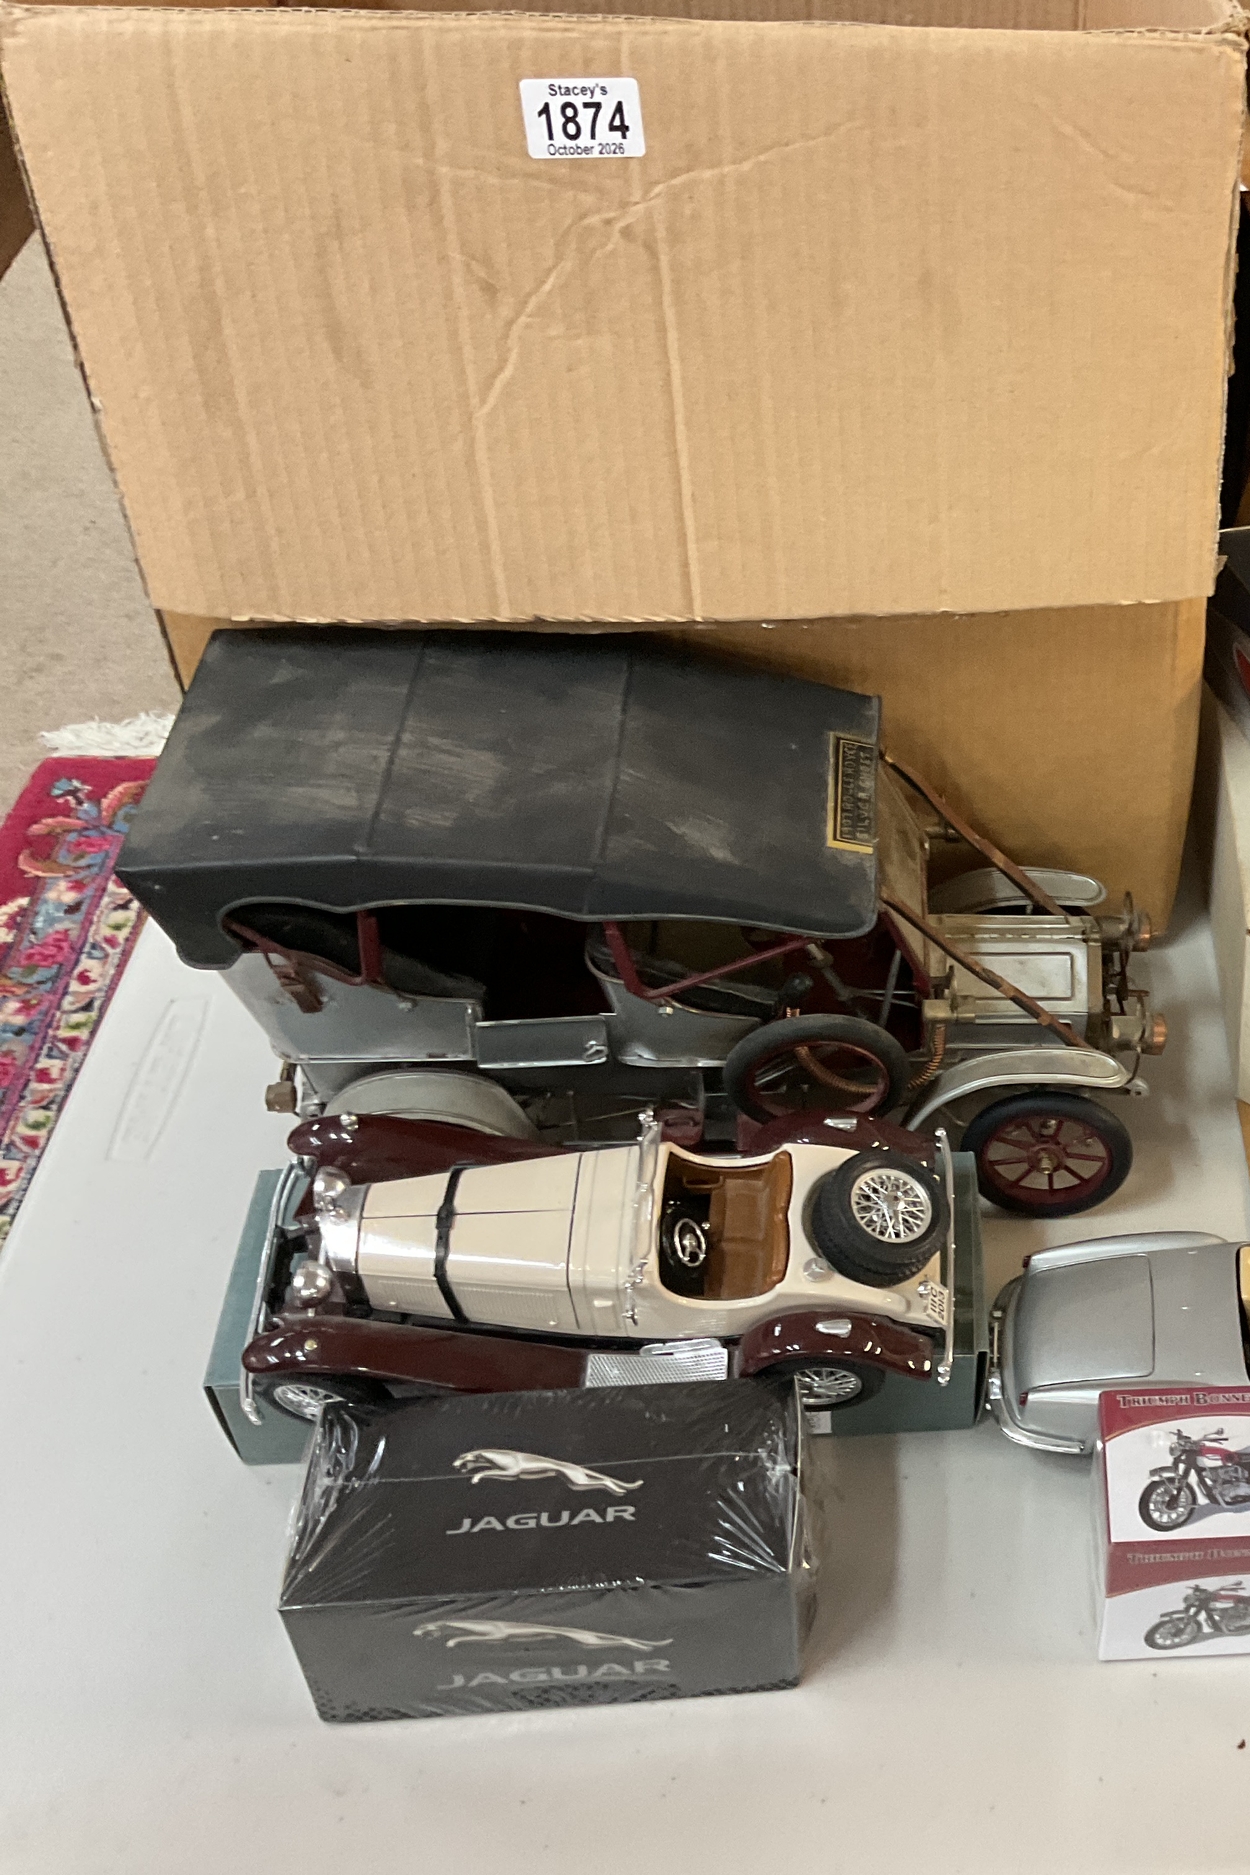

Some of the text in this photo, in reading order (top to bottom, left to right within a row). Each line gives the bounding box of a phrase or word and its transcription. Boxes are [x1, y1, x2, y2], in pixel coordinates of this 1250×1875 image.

[548, 83, 608, 99] Stacey's
[537, 101, 630, 141] 1874
[547, 142, 625, 156] October 2026
[1116, 1394, 1190, 1408] TRIUMPH
[445, 1505, 637, 1535] JAGUAR
[437, 1658, 672, 1691] JAGUAR
